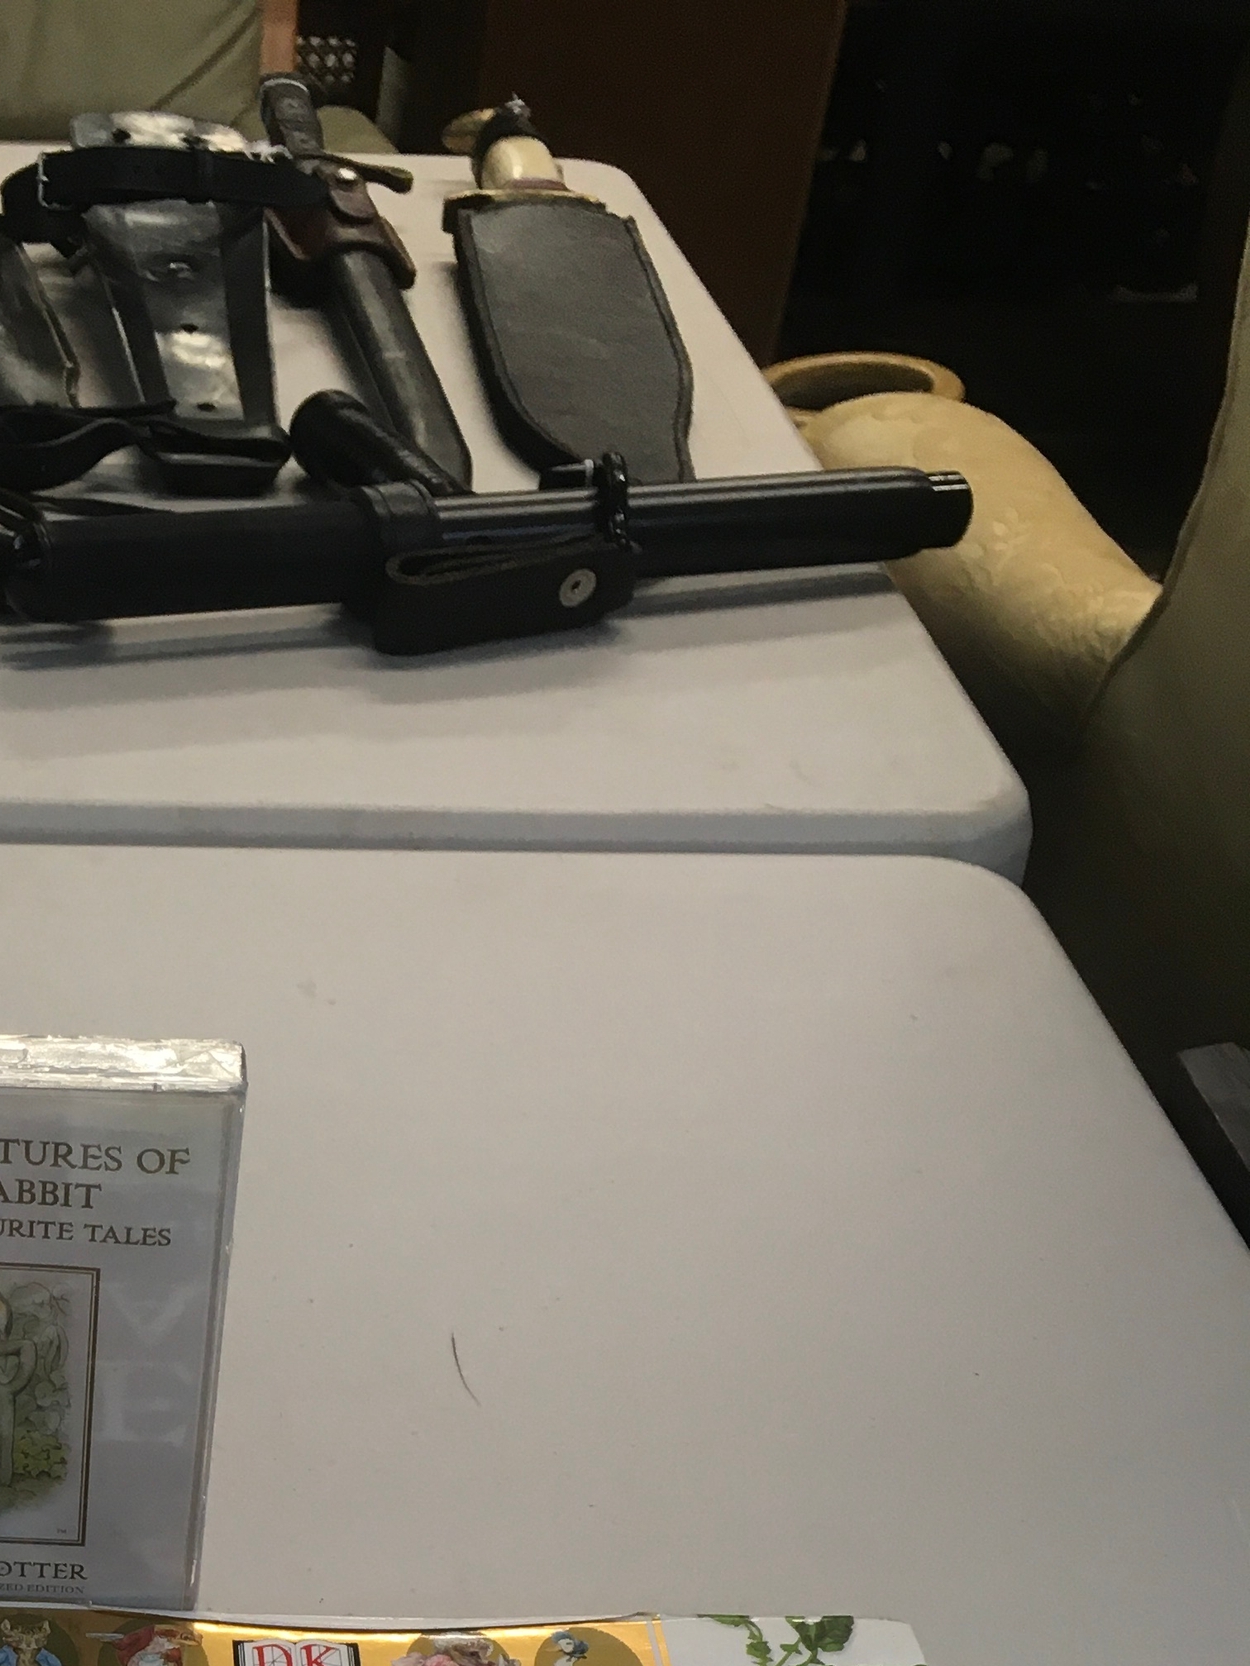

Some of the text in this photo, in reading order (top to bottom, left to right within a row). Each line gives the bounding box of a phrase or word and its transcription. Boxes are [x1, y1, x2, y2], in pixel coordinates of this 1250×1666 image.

[136, 1147, 191, 1176] OF
[83, 1222, 172, 1248] TALES
[27, 1584, 85, 1594] EDITION
